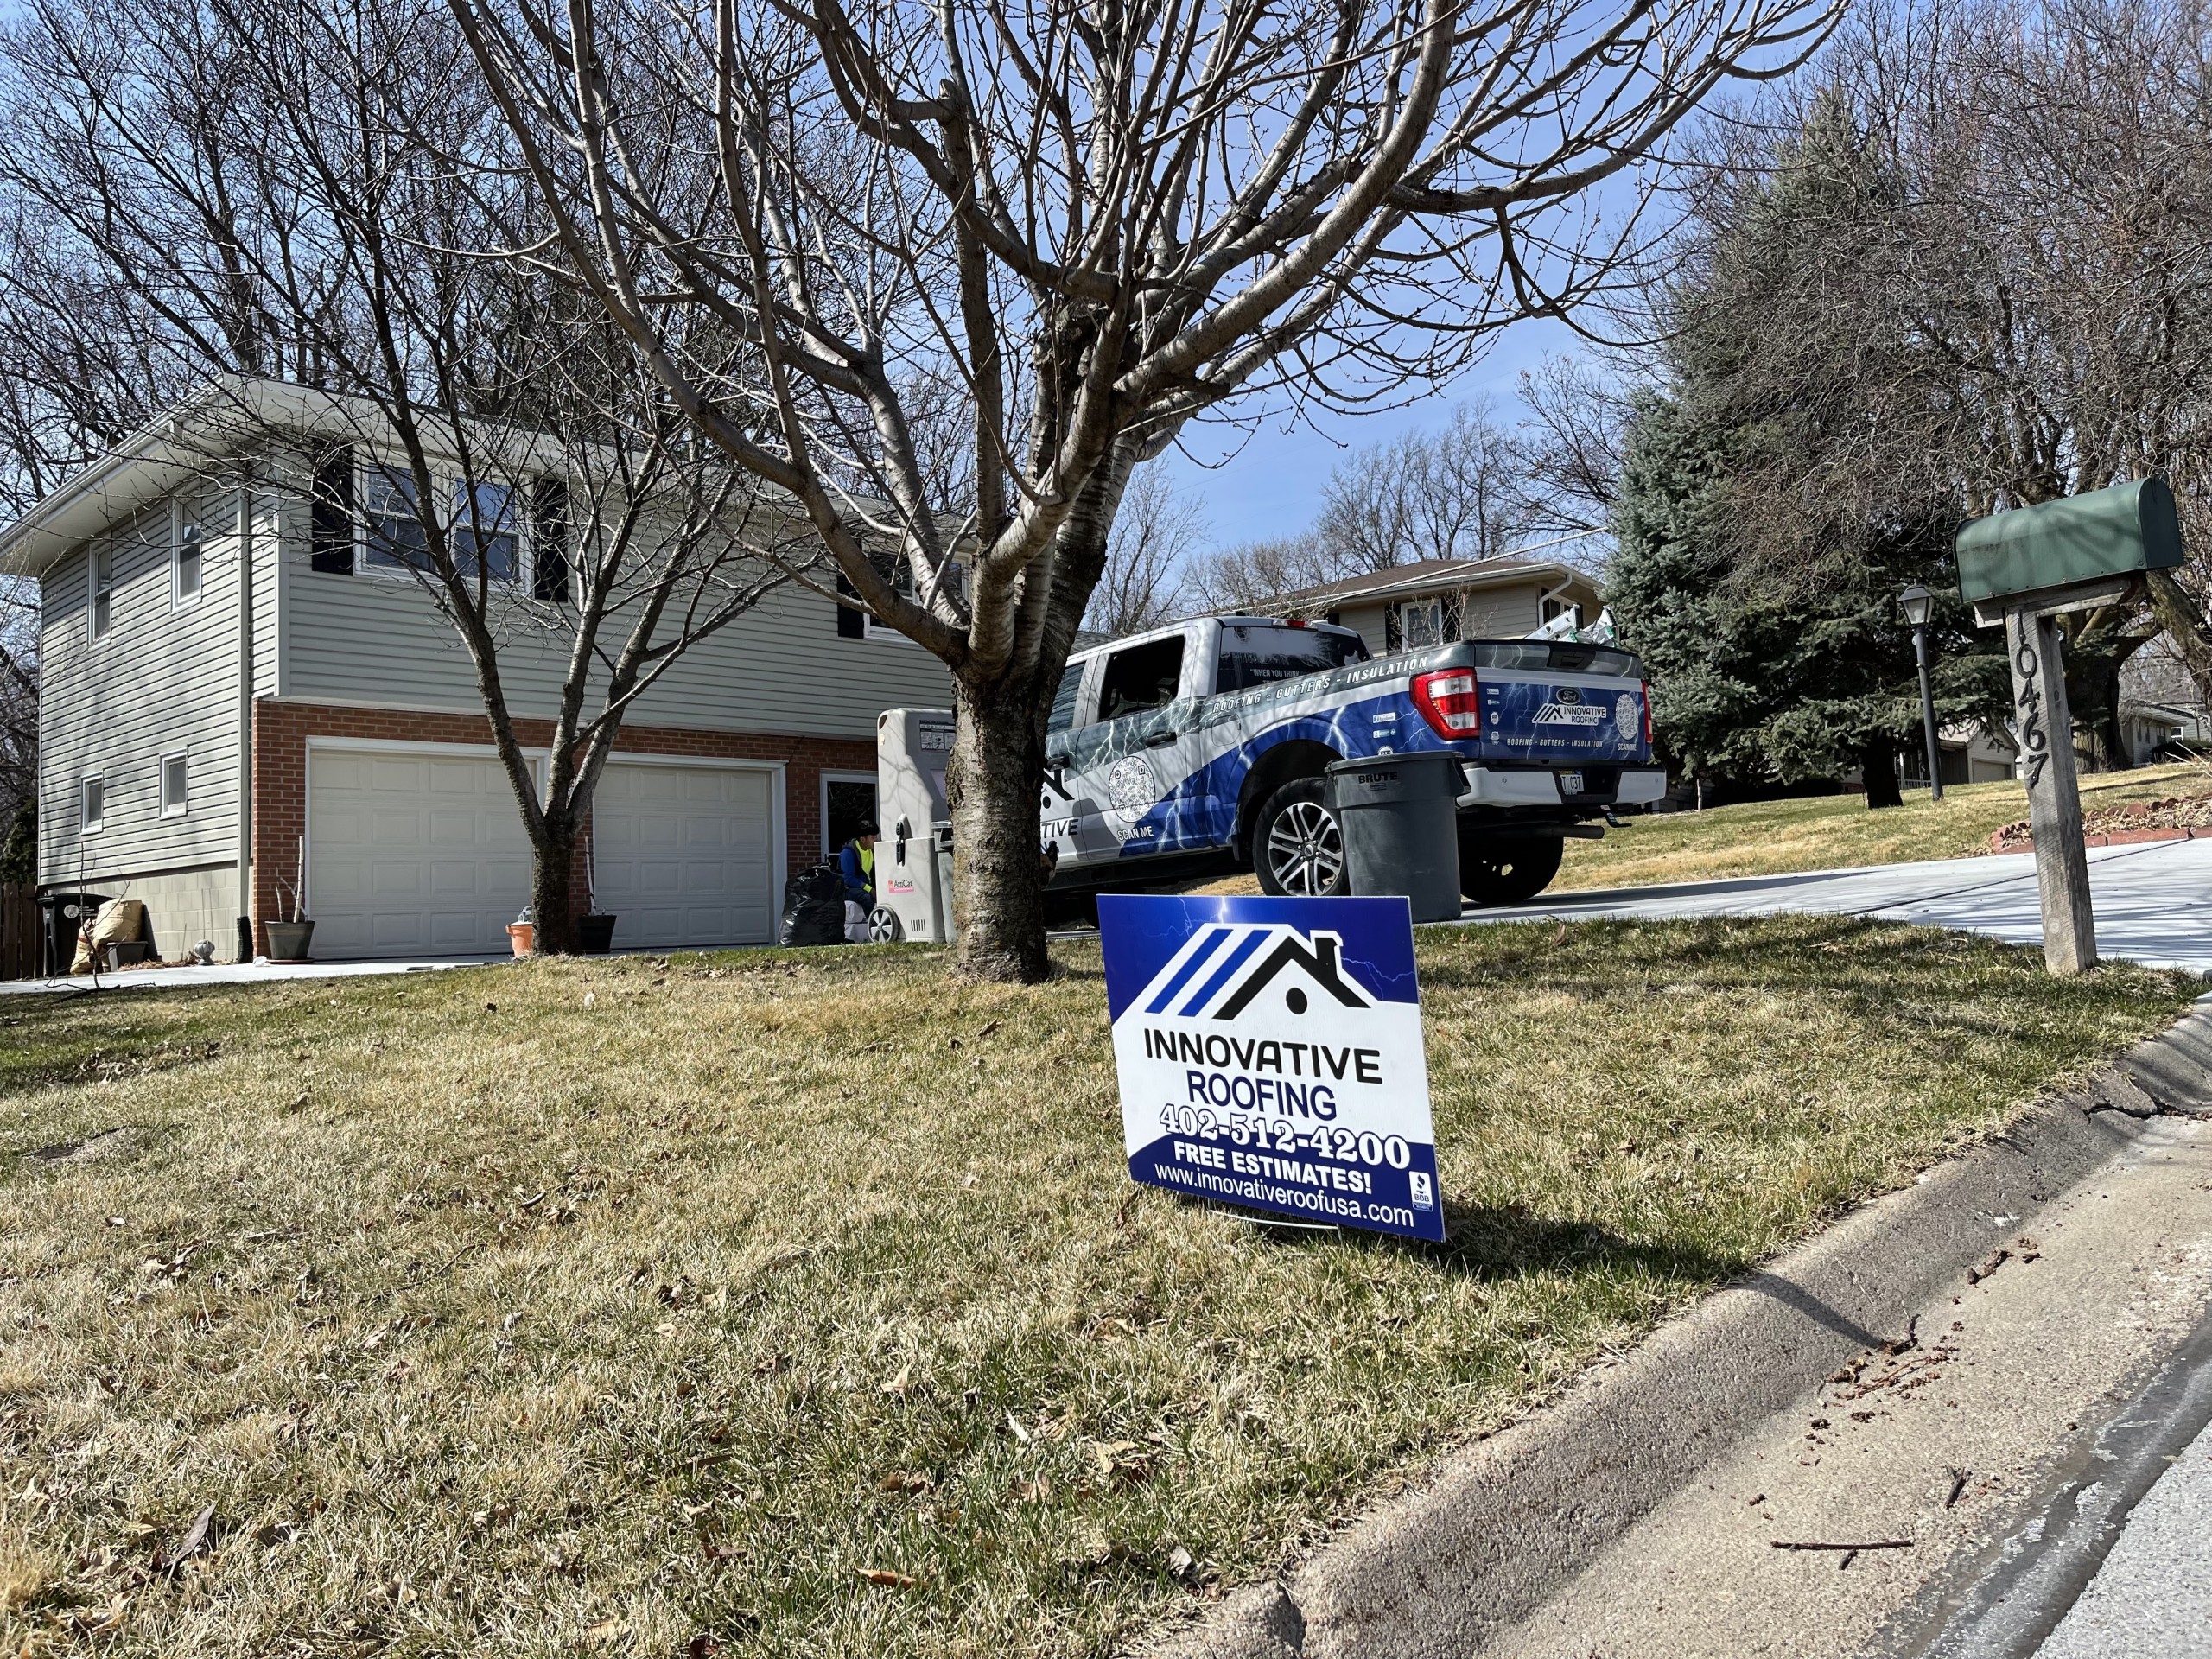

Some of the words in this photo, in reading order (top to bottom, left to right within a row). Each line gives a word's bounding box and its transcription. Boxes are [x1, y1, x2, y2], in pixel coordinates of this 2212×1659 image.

[1213, 694, 1261, 714] ROOFING
[1276, 677, 1331, 699] GUTTERS
[1346, 656, 1427, 683] INSULATION
[2016, 609, 2049, 789] 10467
[1564, 706, 1606, 717] INNOVATIVE
[1572, 715, 1598, 724] ROOFING
[1358, 772, 1398, 784] BRUTE
[1117, 828, 1140, 842] SCAN
[1140, 825, 1154, 838] ME
[1143, 1027, 1383, 1084] INNOVATIVE
[1186, 1071, 1337, 1122] ROOFING
[1159, 1103, 1410, 1170] 402-512-4200
[1173, 1141, 1225, 1171] FREE
[1232, 1153, 1371, 1195] ESTIMATES!
[1154, 1163, 1414, 1228] www.innovativeroofusa.com
[1414, 1193, 1430, 1203] BBB
